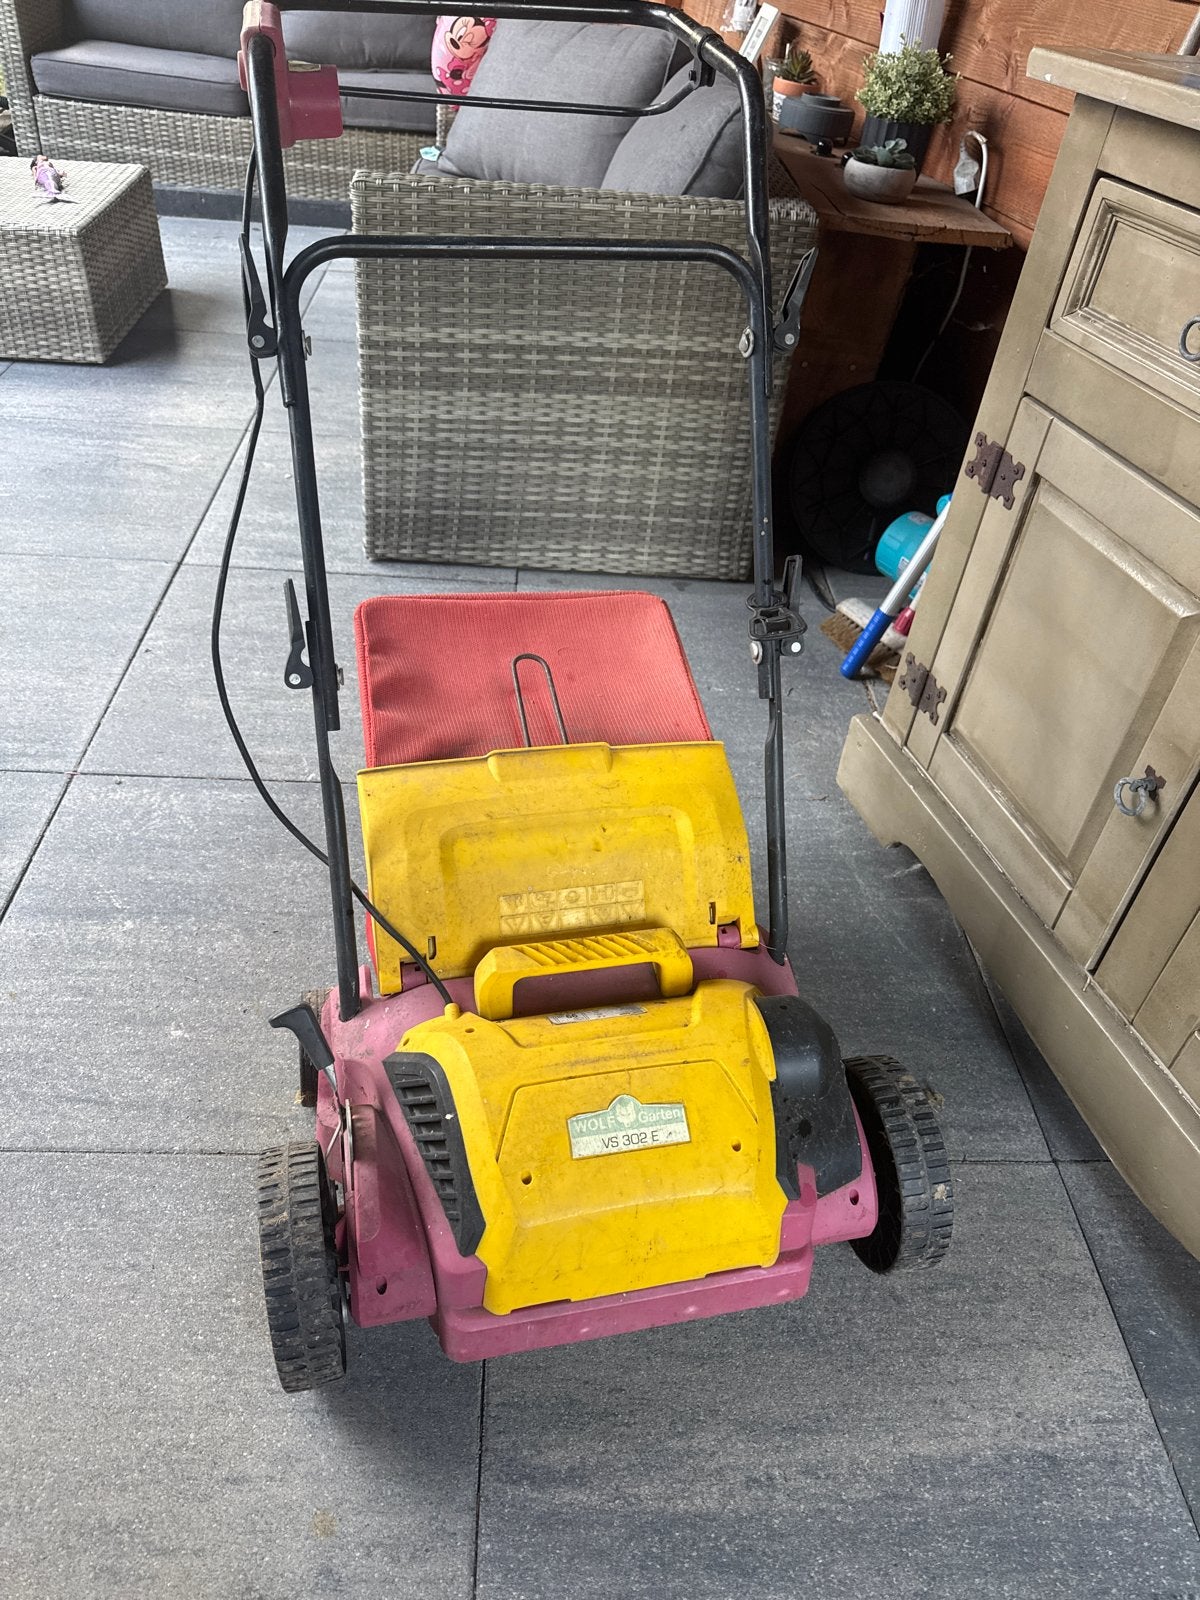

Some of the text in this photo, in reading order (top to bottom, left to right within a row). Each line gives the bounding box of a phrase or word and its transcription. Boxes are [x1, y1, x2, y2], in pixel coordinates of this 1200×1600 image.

[574, 1109, 680, 1132] WOLF Garten
[602, 1130, 660, 1149] VS 302 E
